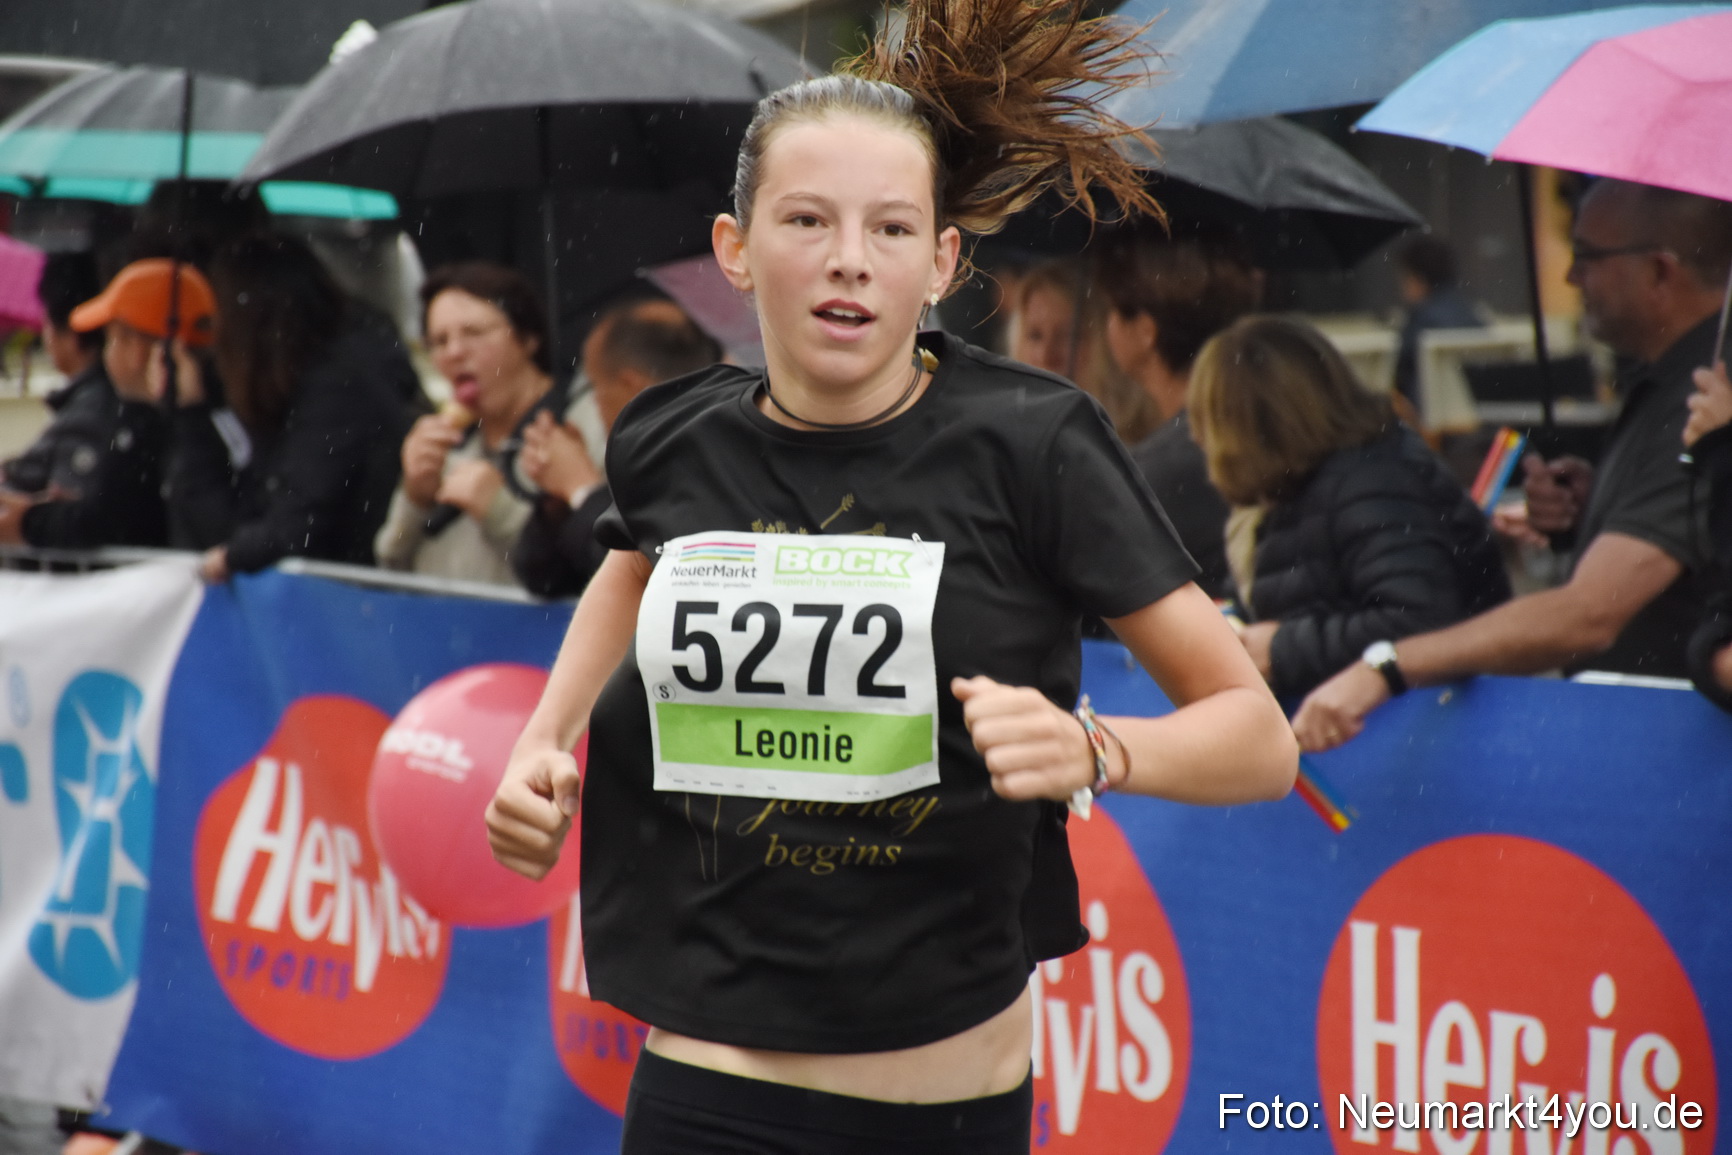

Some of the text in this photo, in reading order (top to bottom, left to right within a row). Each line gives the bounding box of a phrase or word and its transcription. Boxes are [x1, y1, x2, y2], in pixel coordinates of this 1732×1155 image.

[671, 564, 757, 578] NeuerMarkt
[775, 545, 914, 578] BOCK
[772, 577, 911, 590] inspired by smart concepts
[671, 600, 907, 699] 5272
[658, 684, 670, 700] S
[735, 719, 853, 764] Leonie
[764, 833, 902, 876] begins
[1032, 900, 1173, 1136] vis
